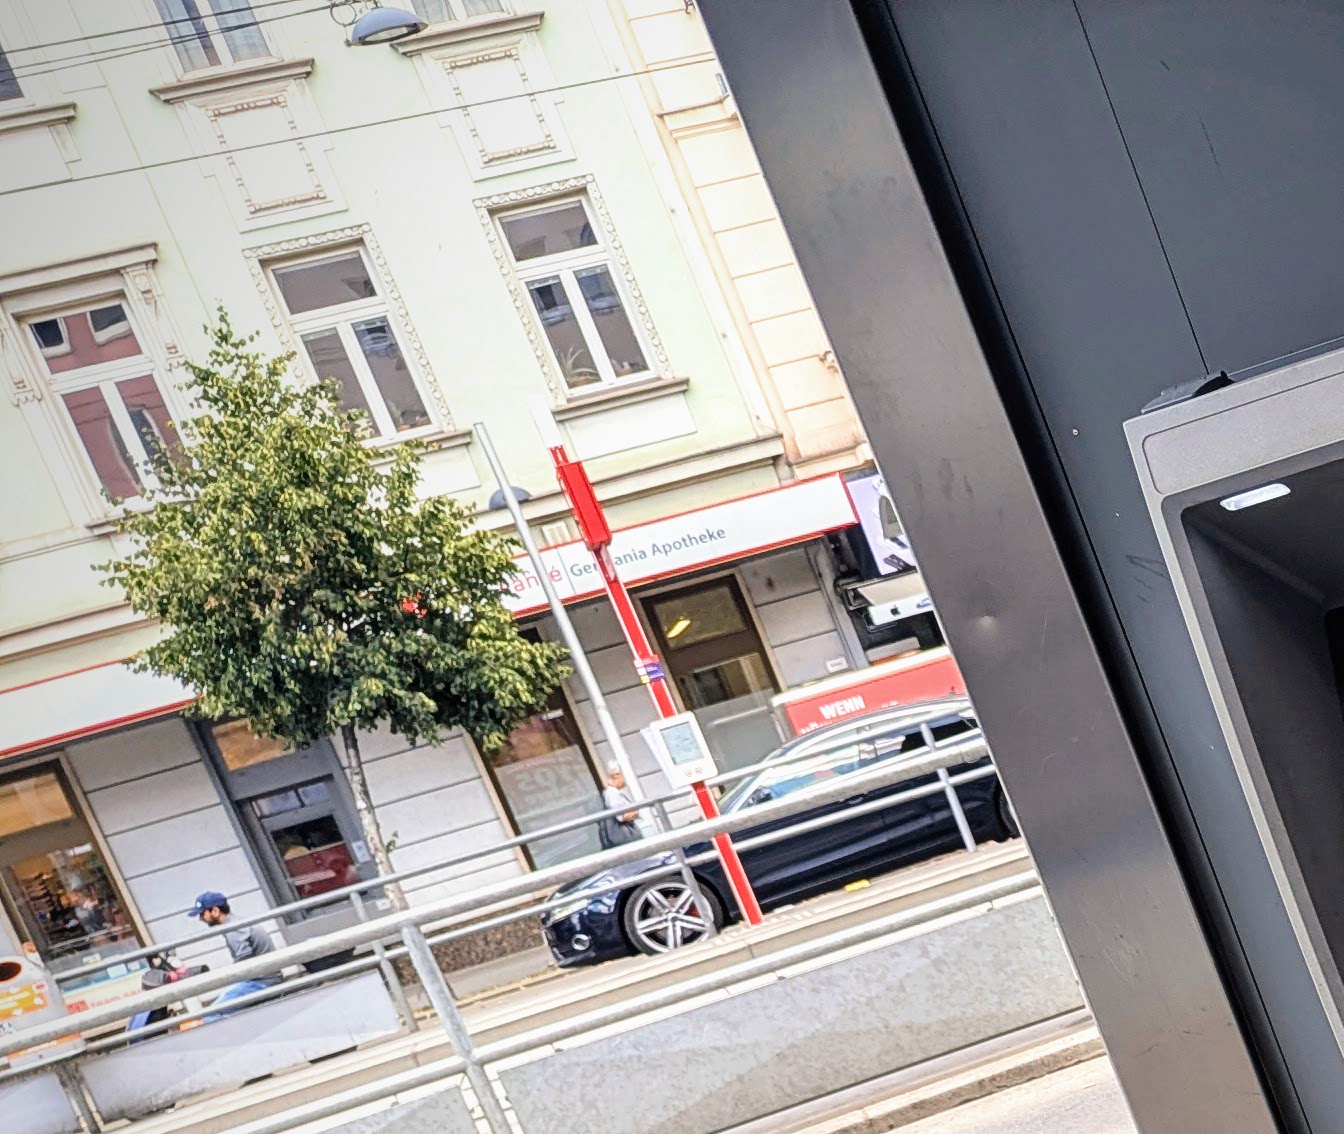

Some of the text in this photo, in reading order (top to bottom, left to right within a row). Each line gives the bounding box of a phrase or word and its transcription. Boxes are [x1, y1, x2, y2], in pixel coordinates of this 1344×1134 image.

[570, 549, 648, 578] Gerania
[651, 526, 727, 561] Apotheke
[819, 695, 866, 720] WENN
